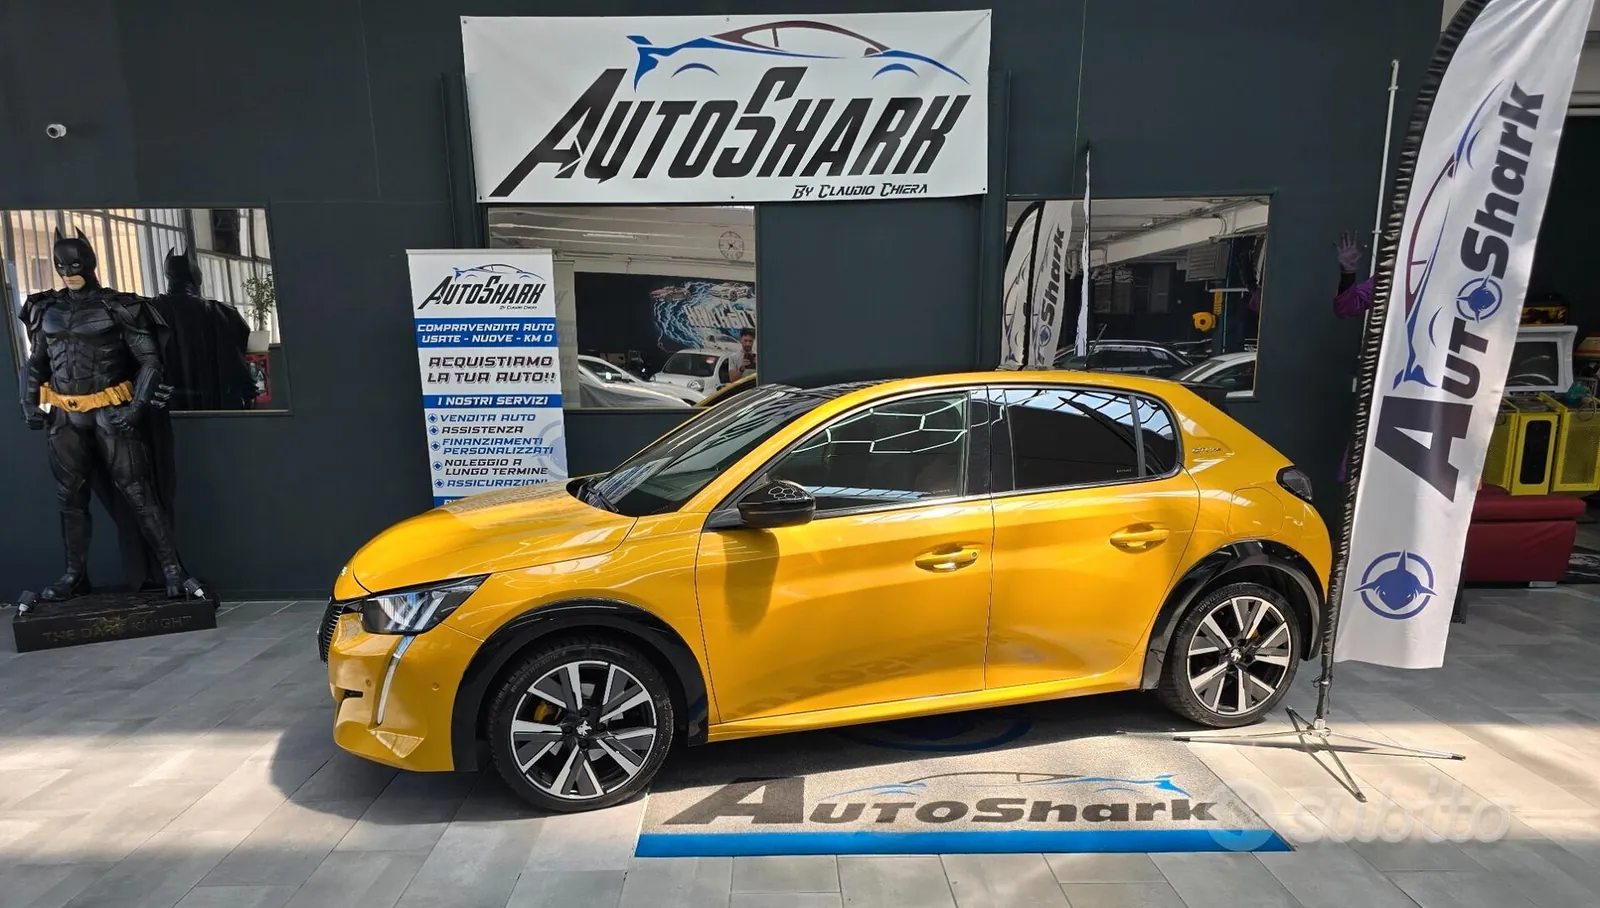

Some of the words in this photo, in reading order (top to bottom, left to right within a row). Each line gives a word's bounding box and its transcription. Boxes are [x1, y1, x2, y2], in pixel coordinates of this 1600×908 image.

[489, 66, 972, 197] AUTOSHARK
[792, 185, 814, 199] BY
[819, 184, 875, 198] CLAUDIO
[880, 183, 929, 196] CHIERA
[417, 275, 547, 309] AUTOSHARK
[417, 324, 519, 333] COMPRAVENDITA
[523, 323, 555, 331] AUTO
[422, 335, 461, 343] USATE
[472, 335, 513, 343] NUOVE
[524, 334, 540, 342] KM
[428, 356, 554, 369] ACQUISTIAMO
[427, 372, 450, 384] LA
[455, 372, 491, 384] TUA
[496, 371, 556, 383] AUTO!!
[438, 397, 442, 406] I
[445, 397, 493, 406] NOSTRI
[496, 396, 549, 405] SERVIZI
[440, 414, 497, 422] VENDITA
[501, 414, 536, 422] AUTO
[441, 426, 524, 434] ASSISTENZA
[442, 437, 543, 446] FINANZIAMENTI
[443, 446, 554, 455] PERSONALIZZATI
[444, 459, 509, 467] NOLEGGIO
[513, 458, 522, 466] A
[445, 468, 489, 476] LUNGO
[492, 467, 549, 475] TERMINE
